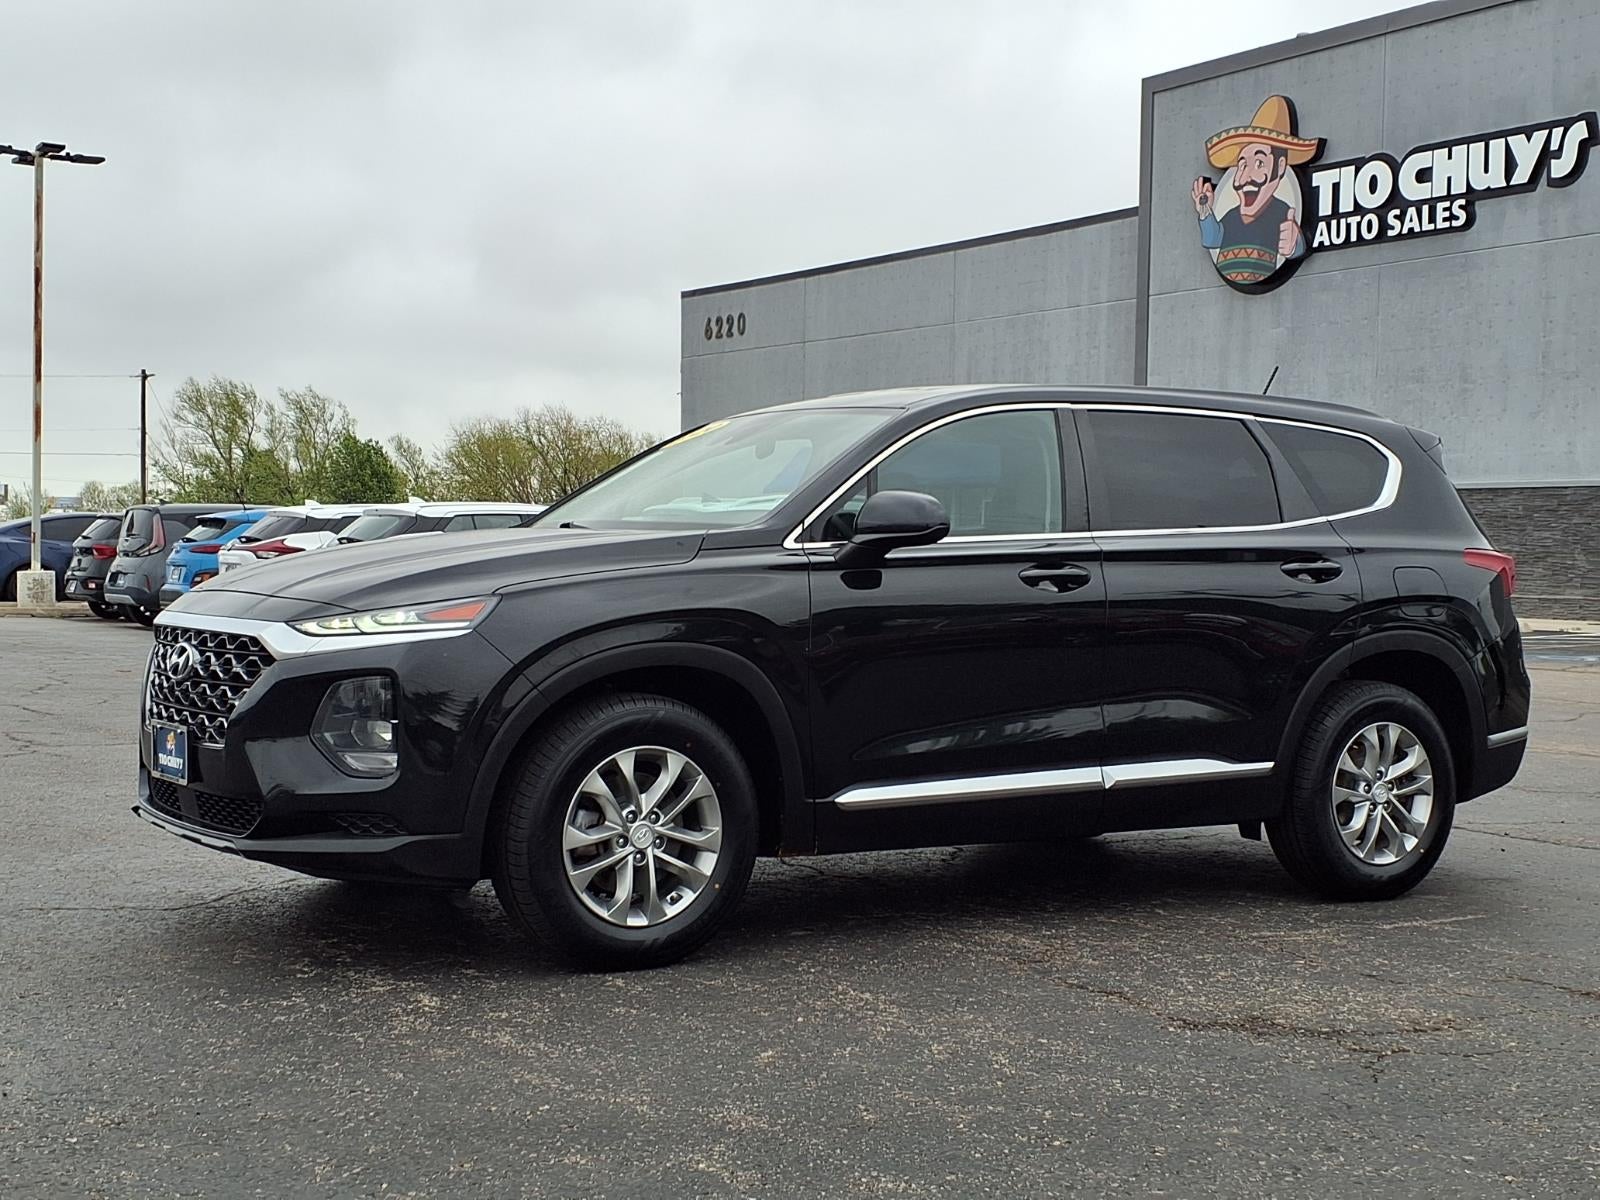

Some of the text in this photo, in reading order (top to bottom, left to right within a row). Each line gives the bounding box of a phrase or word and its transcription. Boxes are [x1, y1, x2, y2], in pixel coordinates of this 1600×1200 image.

[1312, 120, 1589, 217] TIO CHUY'S
[1312, 198, 1467, 248] AUTO SALES
[704, 312, 746, 341] 6220
